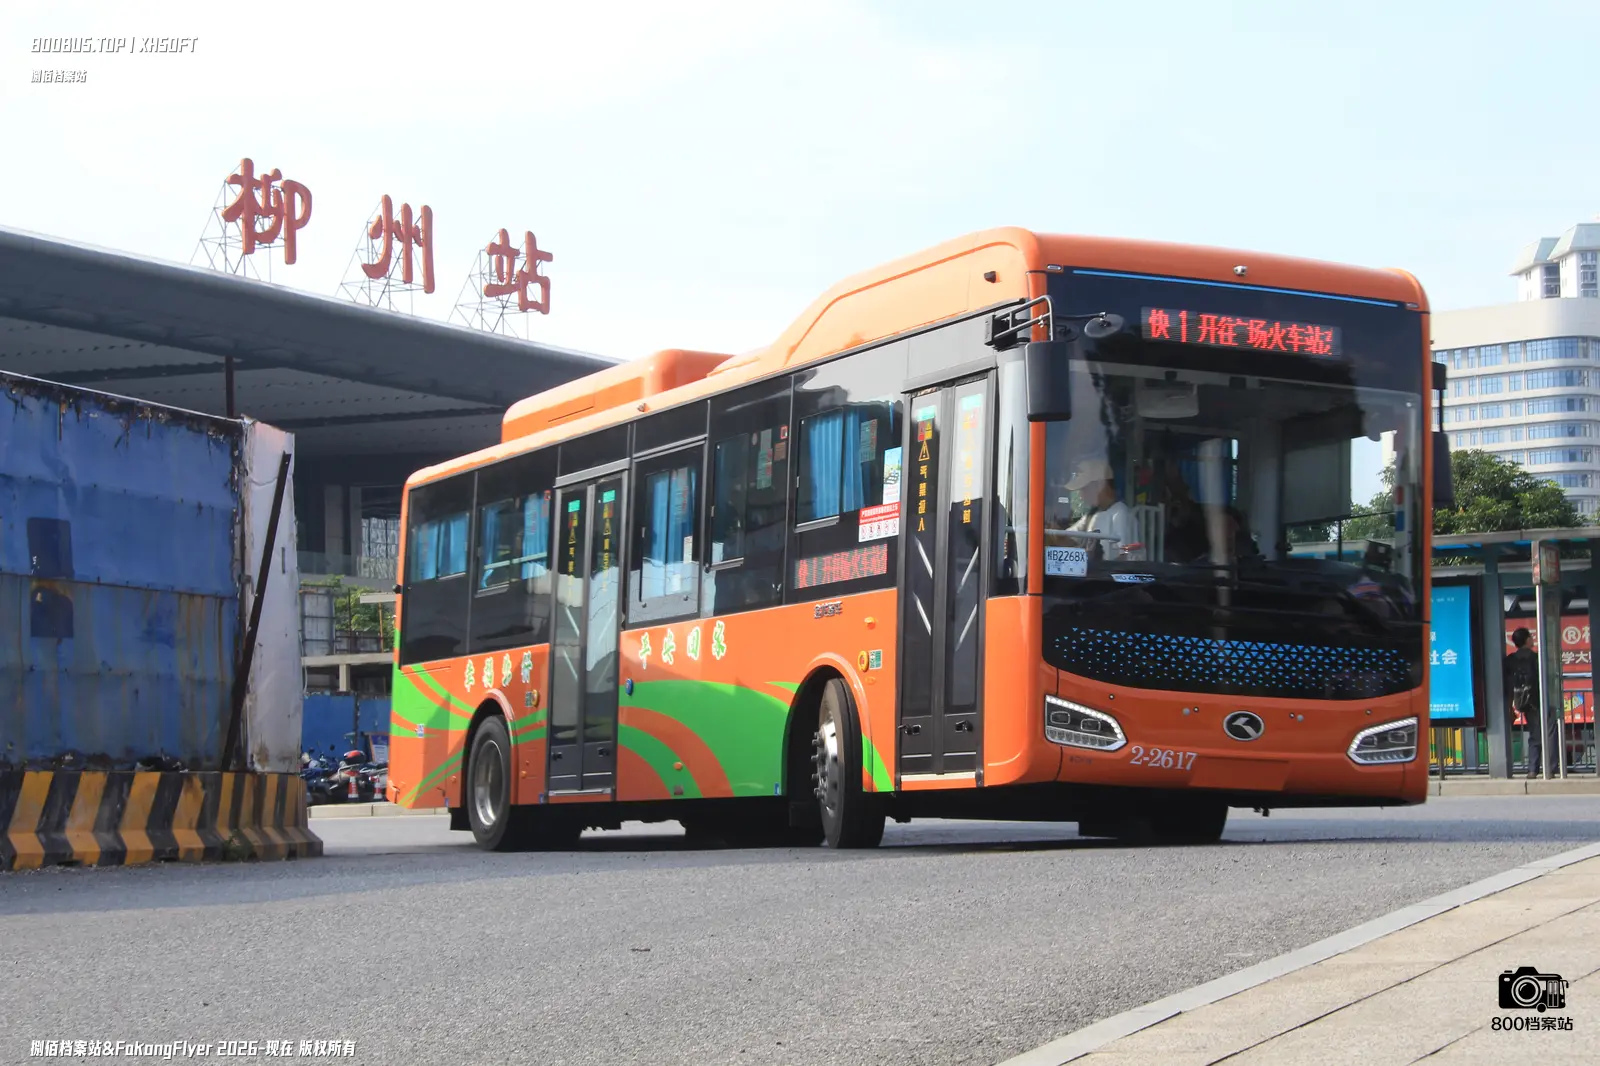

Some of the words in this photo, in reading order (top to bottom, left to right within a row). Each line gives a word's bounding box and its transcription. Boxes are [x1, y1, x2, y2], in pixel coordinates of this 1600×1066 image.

[221, 157, 554, 315] 柳州站
[1130, 746, 1198, 771] 2-2617
